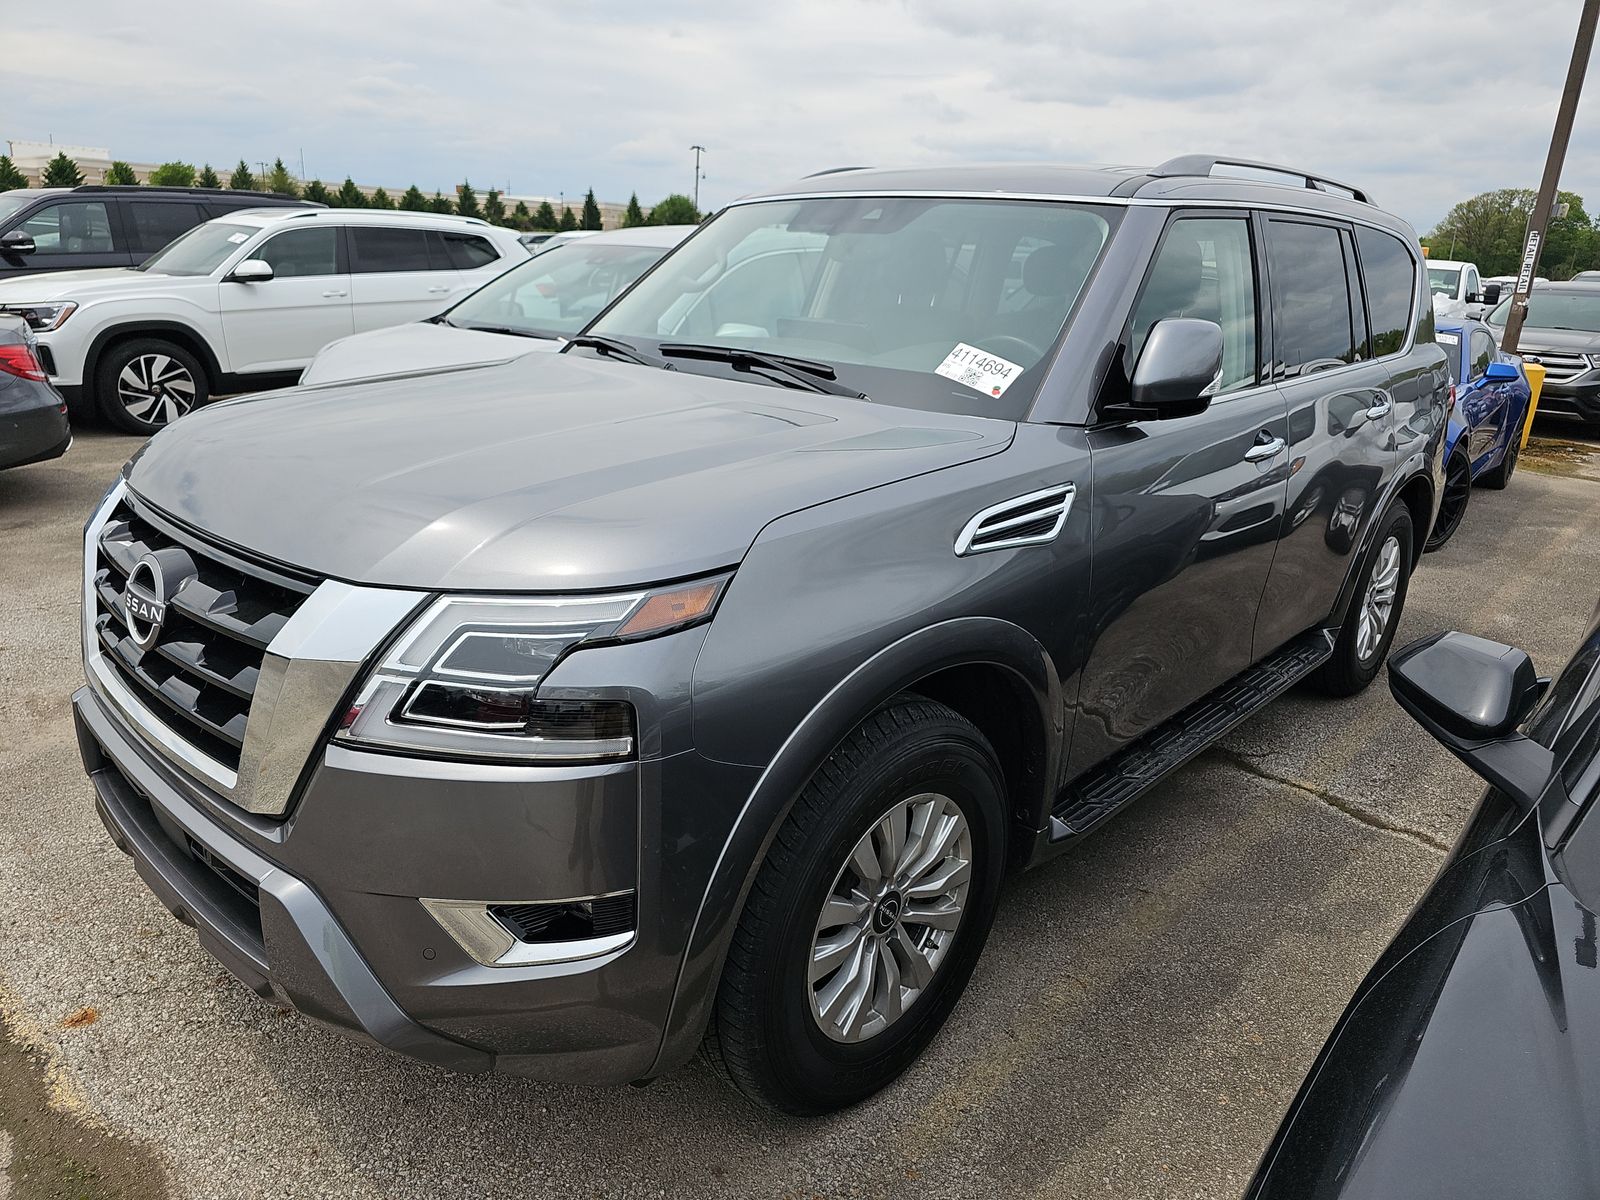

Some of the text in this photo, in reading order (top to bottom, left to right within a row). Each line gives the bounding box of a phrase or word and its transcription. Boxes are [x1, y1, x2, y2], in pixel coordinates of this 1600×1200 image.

[1526, 232, 1539, 261] RETAIL
[1518, 263, 1531, 291] RETAIL
[952, 348, 1013, 379] 4114694
[126, 593, 163, 622] SSAN
